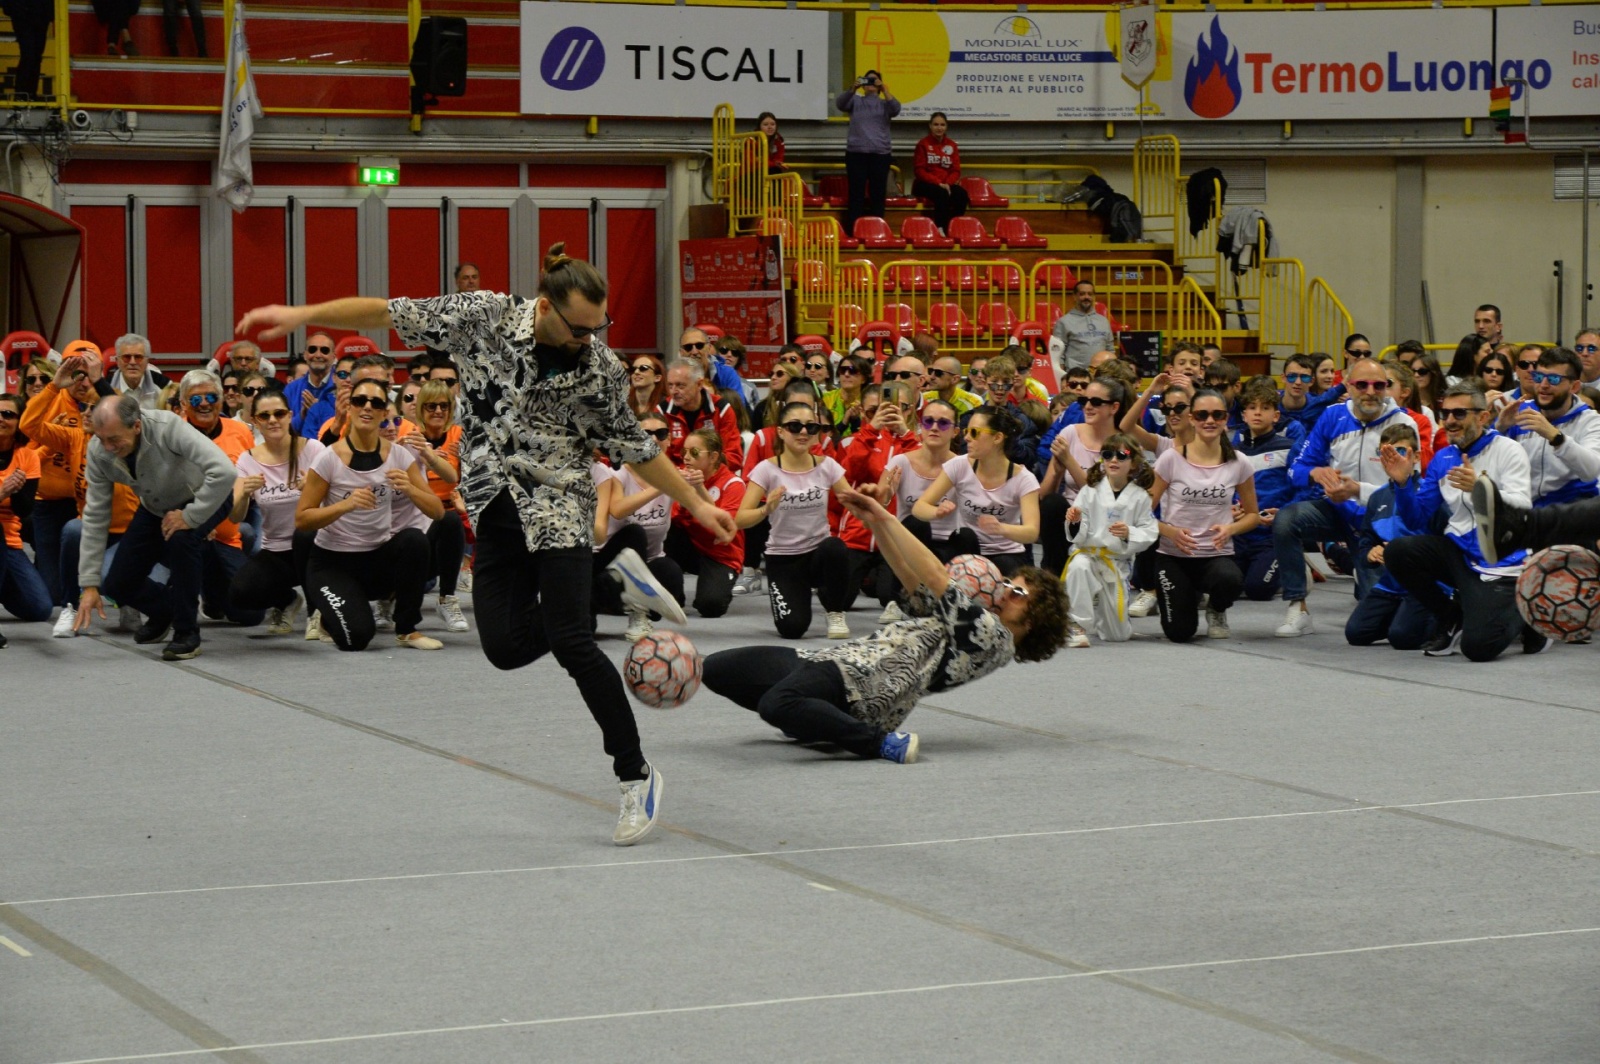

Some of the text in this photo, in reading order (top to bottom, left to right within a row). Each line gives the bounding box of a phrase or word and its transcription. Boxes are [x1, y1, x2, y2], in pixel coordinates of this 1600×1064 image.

[965, 39, 1042, 48] MONDIAL
[625, 44, 804, 84] TISCALI
[964, 53, 1082, 62] MEGASTORE DELLA LUCE
[956, 74, 1084, 83] PRODUZIONE E VENDITA
[1245, 51, 1552, 101] TermoLuongo
[956, 85, 1084, 94] DIRETTA AL PUBBLICO
[780, 485, 823, 504] aretè
[1182, 483, 1228, 499] aretè
[964, 499, 1007, 516] aretè
[1158, 570, 1176, 593] aretè
[320, 586, 346, 610] aretè
[771, 581, 792, 620] aretè
